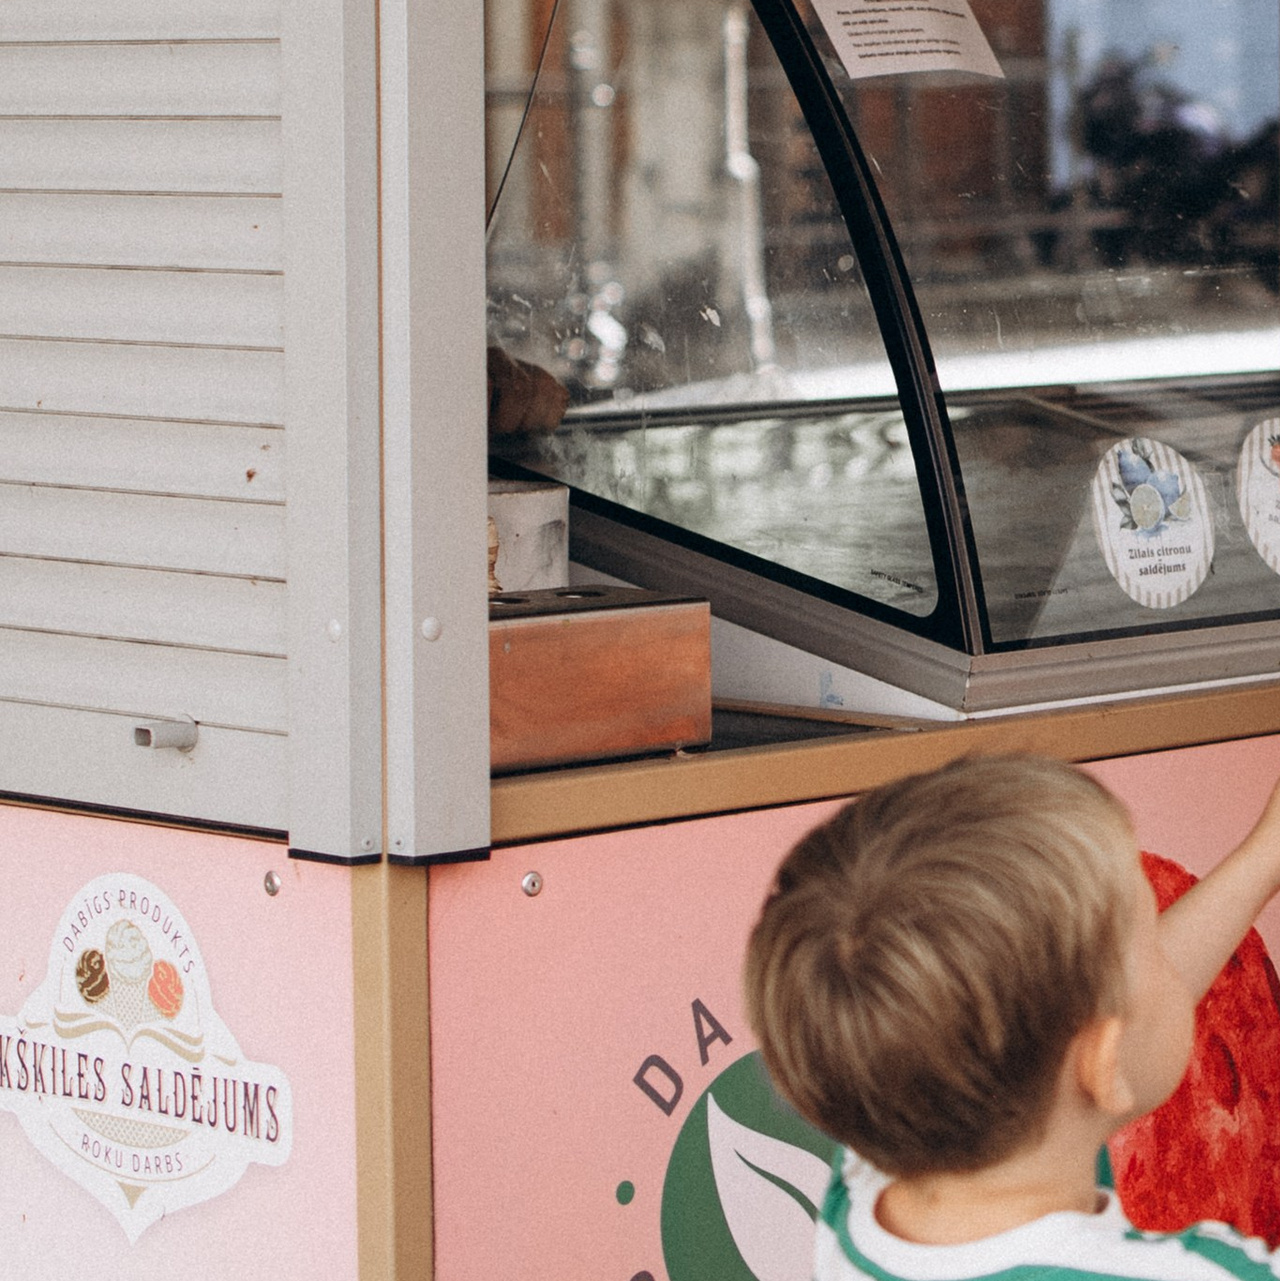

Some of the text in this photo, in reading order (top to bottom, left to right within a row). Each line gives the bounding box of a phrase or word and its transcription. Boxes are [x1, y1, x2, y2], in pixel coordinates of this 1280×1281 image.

[1128, 545, 1192, 560] Zilais citronu
[62, 888, 196, 974] DABĪGS PRODUKTS
[121, 1062, 280, 1143] SALDĒJUMS
[81, 1133, 184, 1174] ROKU DARBS
